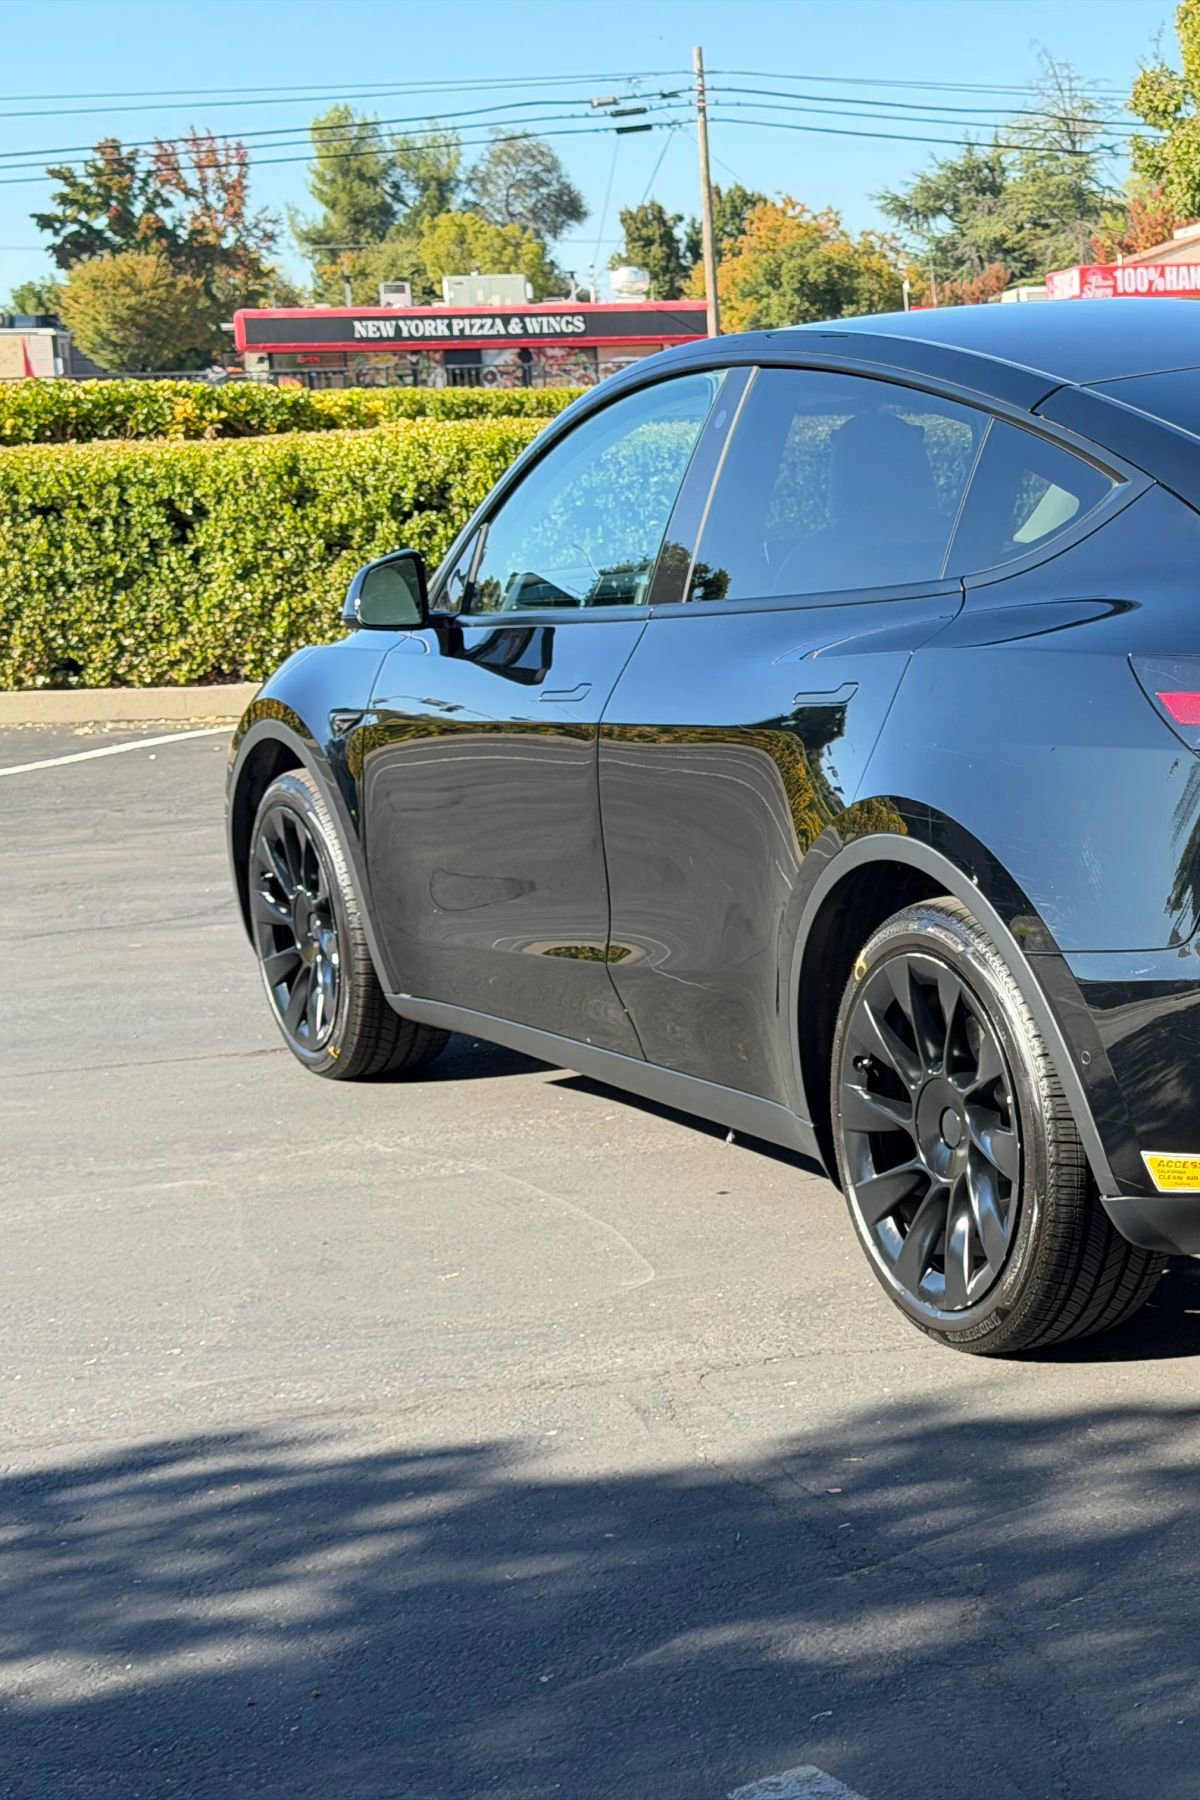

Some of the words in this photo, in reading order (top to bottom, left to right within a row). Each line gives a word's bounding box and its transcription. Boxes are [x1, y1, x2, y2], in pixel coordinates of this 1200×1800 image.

[1113, 268, 1164, 294] 100%
[353, 320, 396, 339] NEW
[398, 318, 450, 338] YORK
[451, 317, 507, 336] PIZZA
[507, 317, 524, 335] &
[524, 315, 586, 334] WINGS
